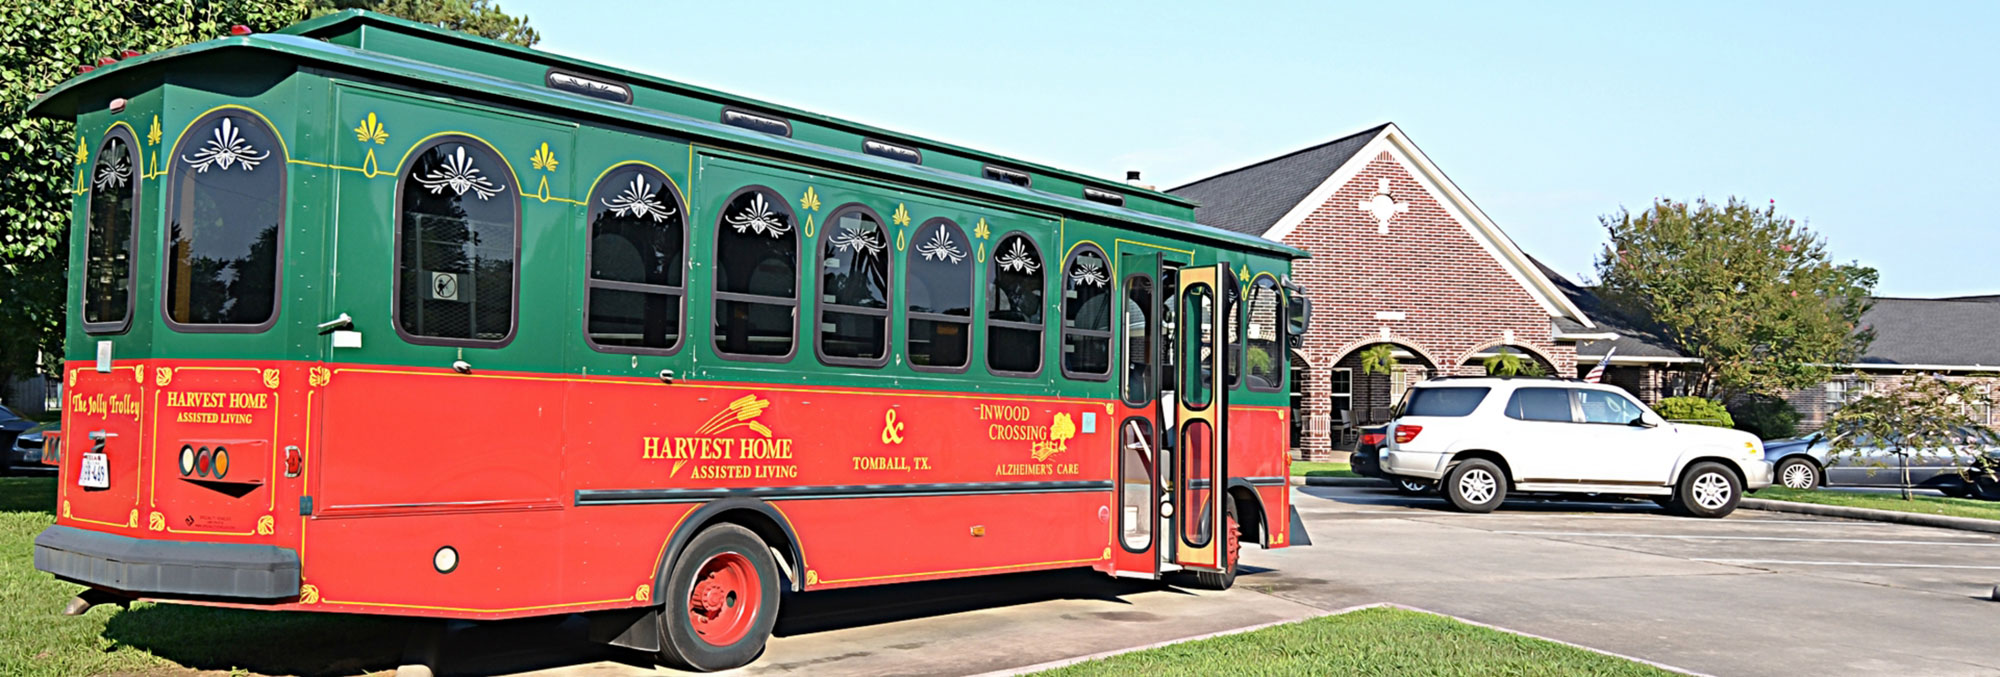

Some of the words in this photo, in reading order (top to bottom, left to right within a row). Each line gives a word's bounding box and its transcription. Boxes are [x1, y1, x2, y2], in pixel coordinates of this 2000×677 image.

[73, 393, 87, 412] The
[88, 394, 106, 420] Jolly
[110, 394, 139, 421] Trolley
[167, 392, 226, 407] HARVEST
[230, 393, 268, 409] HOME
[177, 413, 218, 423] ASSISTED
[221, 414, 252, 424] LIVING
[980, 404, 1029, 421] INWOOD
[882, 408, 904, 444] &
[989, 424, 1047, 441] CROSSING
[643, 437, 734, 459] HARVEST
[740, 439, 792, 459] HOME
[691, 466, 751, 478] ASSISTED
[755, 465, 797, 478] LIVING
[853, 457, 910, 472] TOMBALL,
[914, 457, 931, 469] TX.
[996, 464, 1052, 475] ALZHEIMER'S
[1057, 464, 1078, 474] CARE
